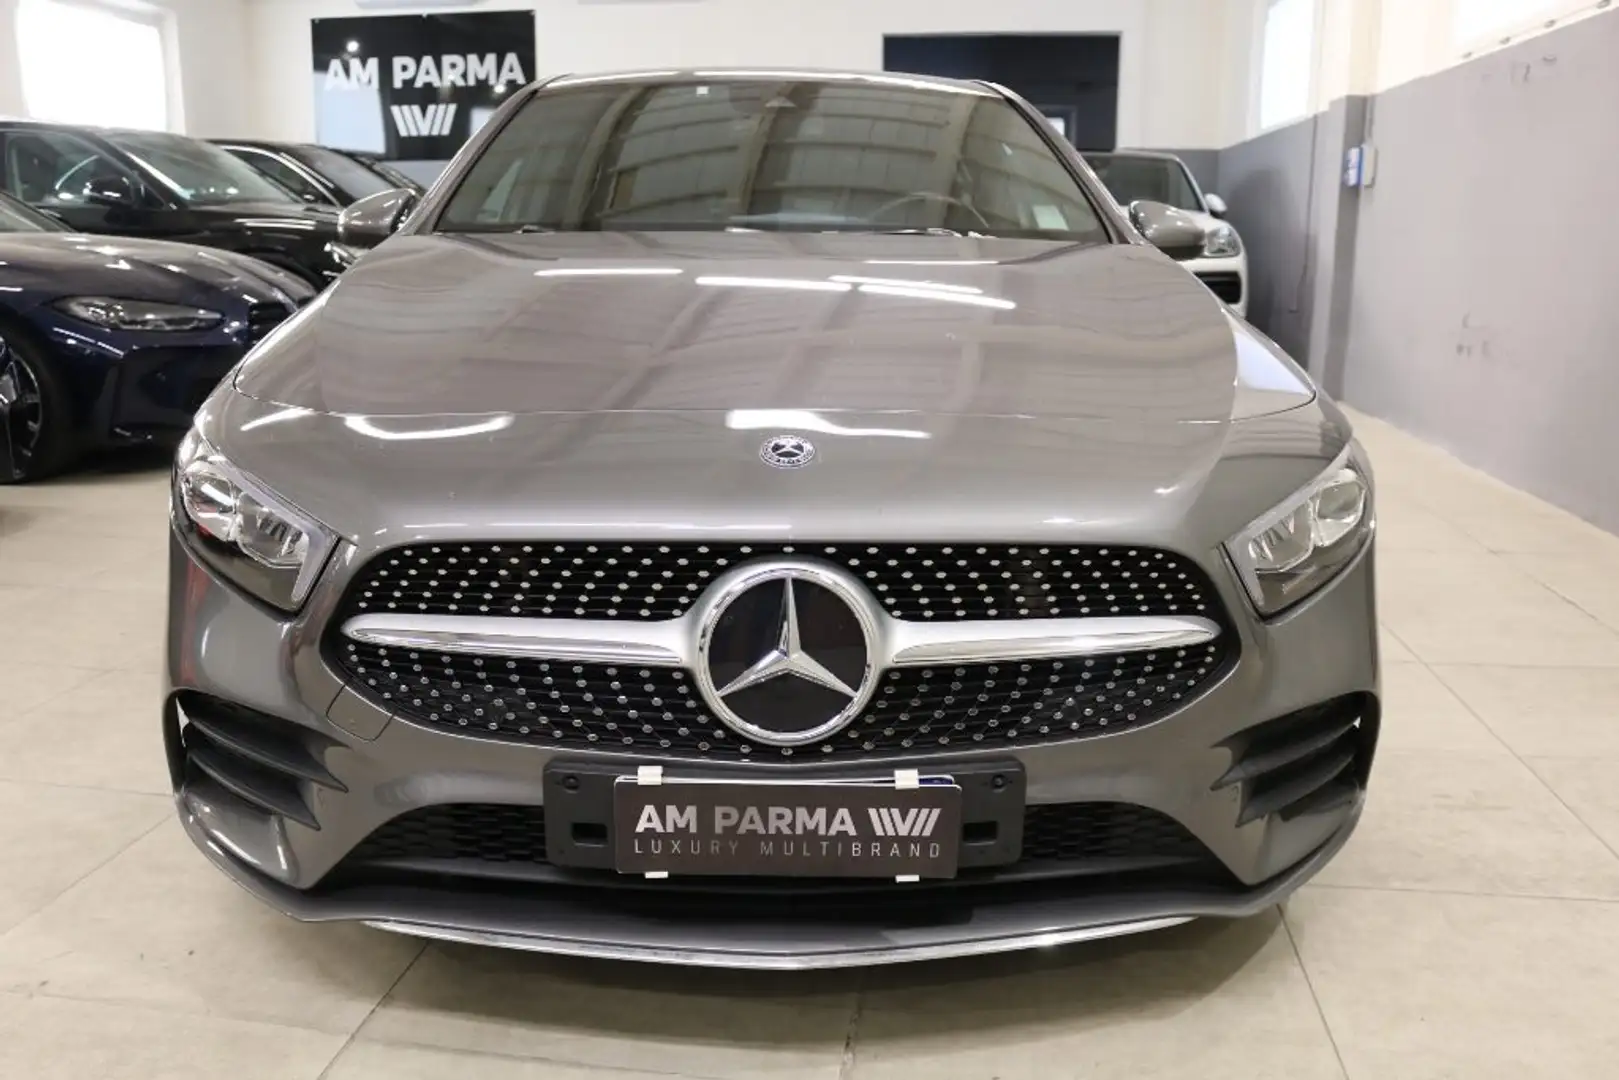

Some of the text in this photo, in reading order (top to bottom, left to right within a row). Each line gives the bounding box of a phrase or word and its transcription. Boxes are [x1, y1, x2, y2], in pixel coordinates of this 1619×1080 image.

[324, 52, 526, 90] AM PARMA
[635, 804, 857, 836] AM PARMA
[634, 839, 940, 858] LUXURY MULTIBRAND
